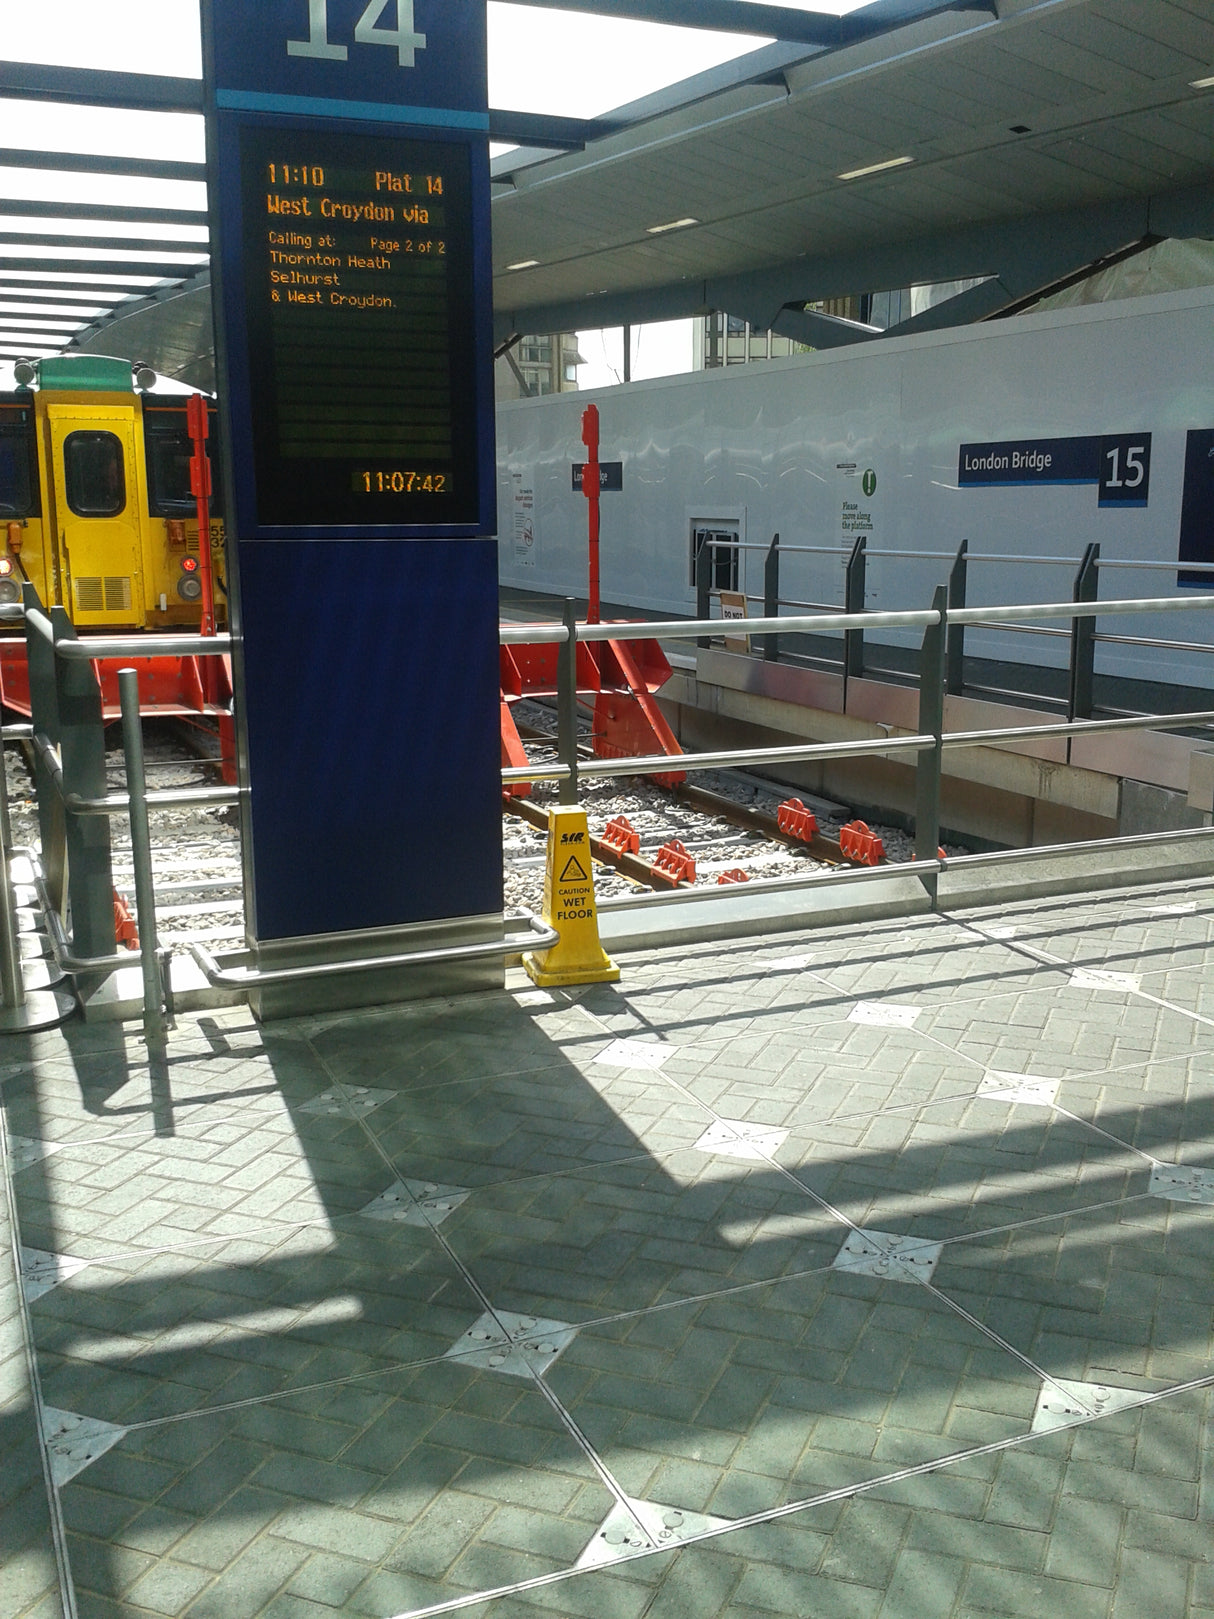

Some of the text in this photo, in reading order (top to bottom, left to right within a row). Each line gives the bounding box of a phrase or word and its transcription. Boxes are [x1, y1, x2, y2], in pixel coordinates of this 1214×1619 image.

[286, 0, 427, 68] 14
[268, 163, 443, 195] 11:10 Plat 14
[267, 194, 429, 224] West Croydon via
[268, 231, 446, 254] Calling at: Page 2 of 2
[270, 250, 391, 269] Thornton Heath
[270, 270, 340, 286] Selhurst
[271, 289, 397, 309] & West Croydon.
[965, 450, 1052, 472] London Bridge
[1105, 446, 1145, 488] 15
[362, 471, 446, 493] 11:07:42
[842, 501, 858, 510] Please
[851, 521, 873, 531] platform
[724, 610, 731, 619] DO
[558, 887, 590, 896] CAUTION
[563, 897, 586, 908] WET
[557, 909, 593, 920] FLOOR
